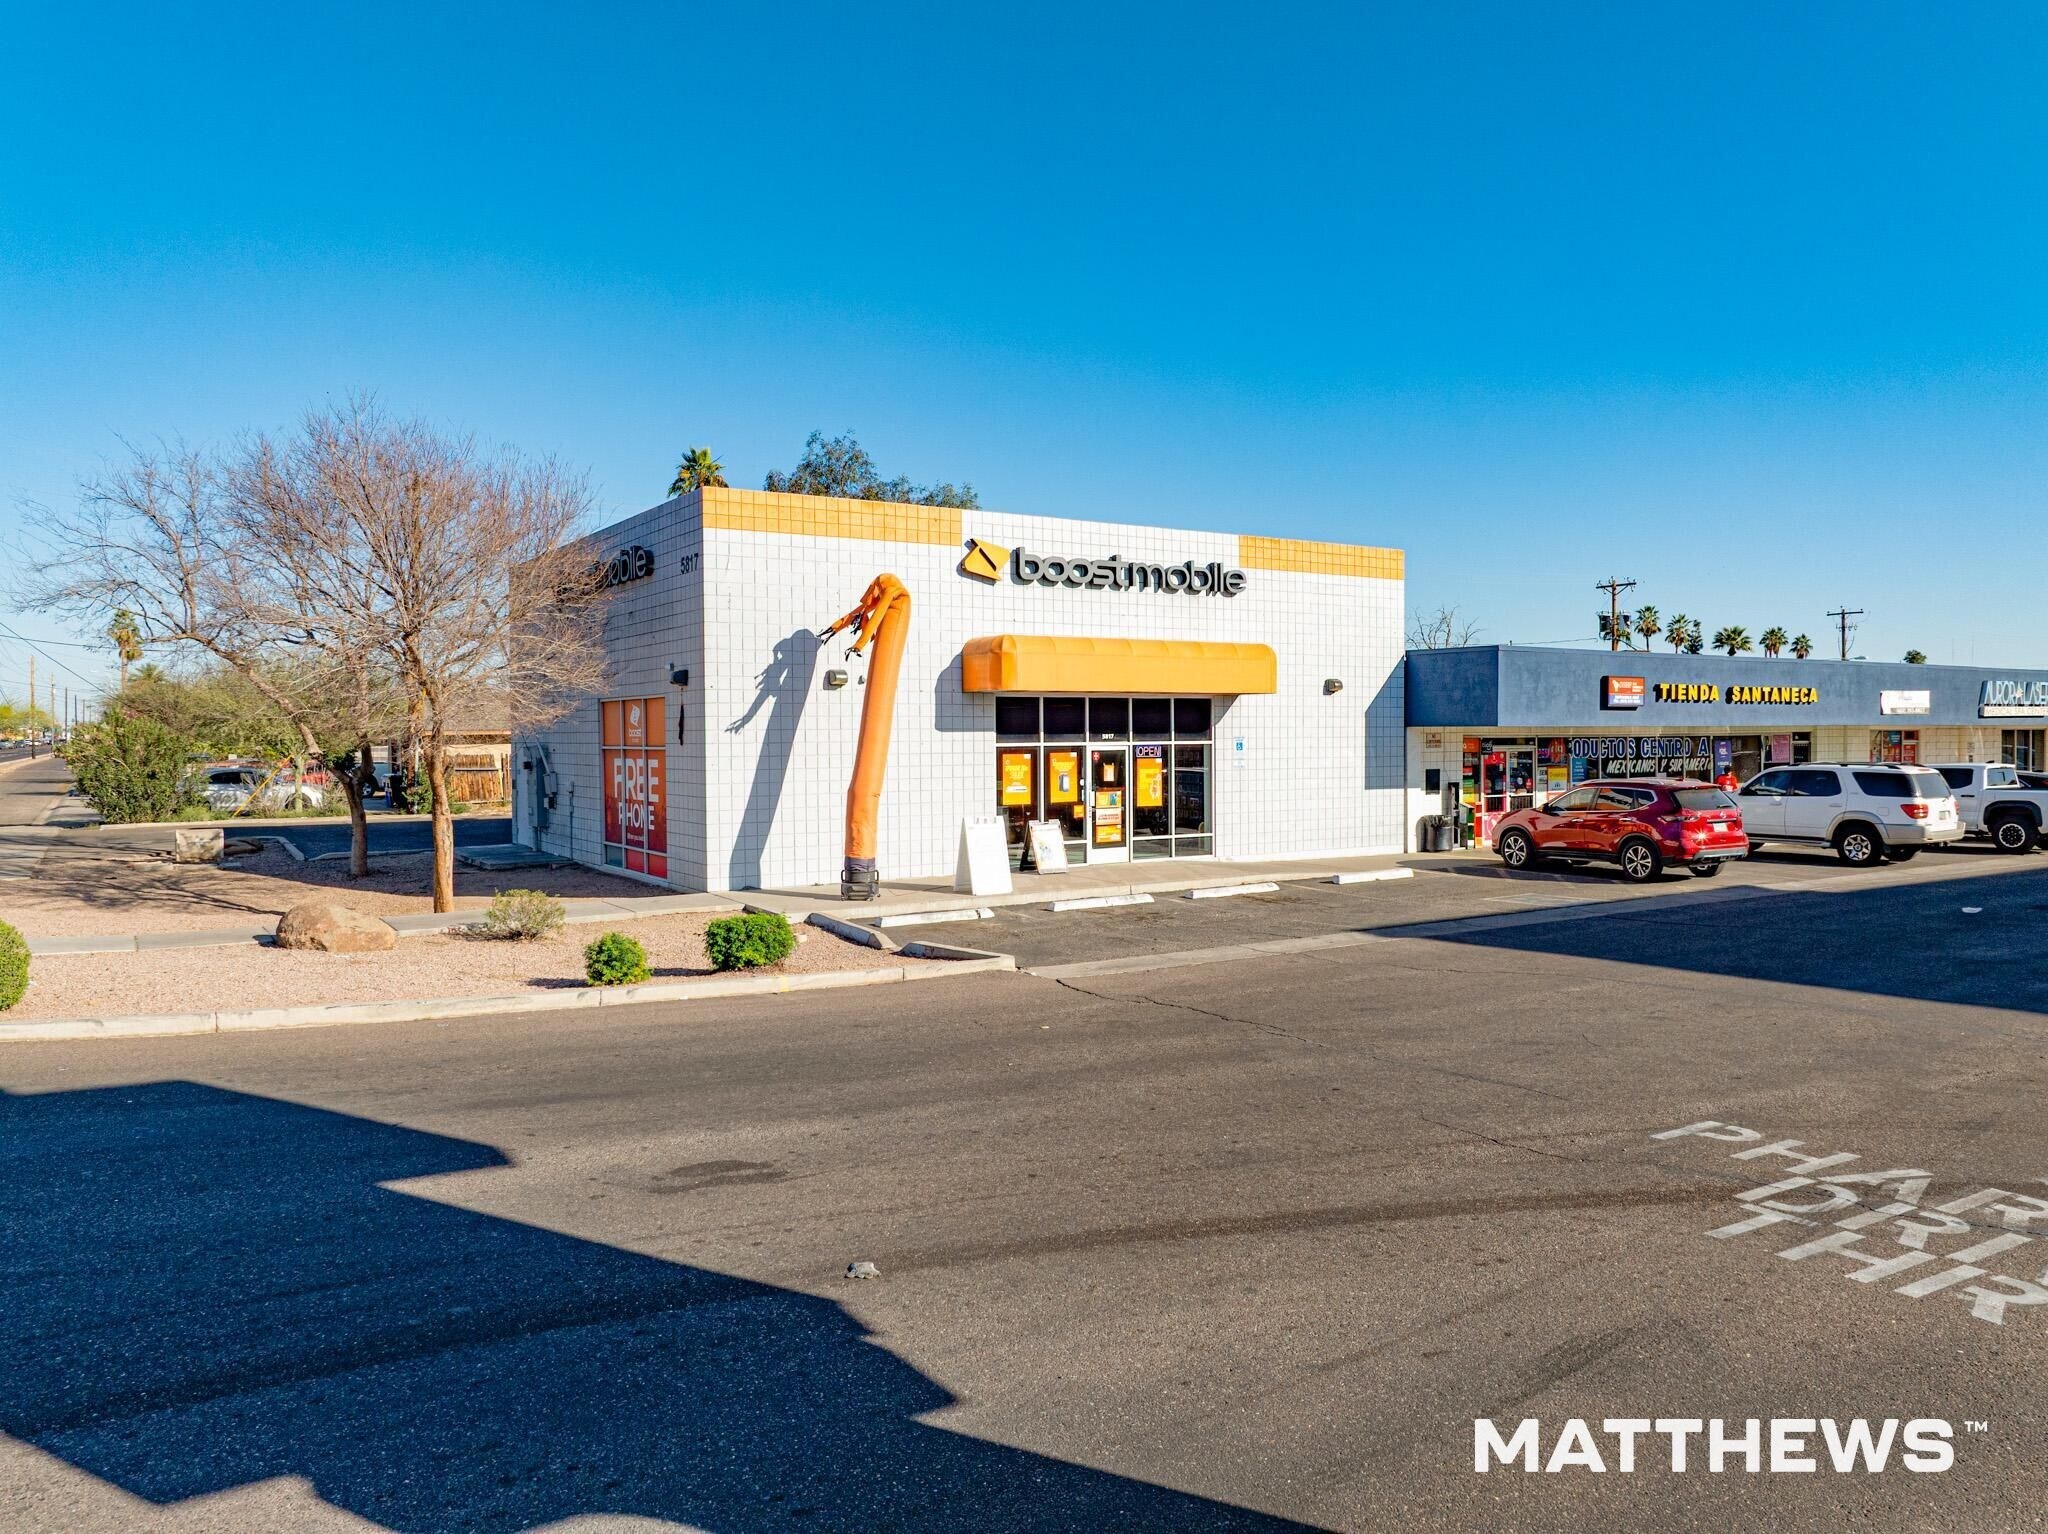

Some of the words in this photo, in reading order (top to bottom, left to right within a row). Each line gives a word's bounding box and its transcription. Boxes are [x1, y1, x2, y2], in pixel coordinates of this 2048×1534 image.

[680, 553, 699, 574] 5817
[1659, 682, 1720, 703] TIENDA
[1732, 686, 1819, 704] SANTANECA
[1137, 746, 1160, 757] OPEN
[1641, 738, 1690, 757] CENTRO
[1607, 759, 1656, 774] MEXICANOS
[614, 758, 659, 803] FREE
[618, 802, 655, 831] PHONE
[1651, 1121, 2048, 1226] PHAR
[1735, 1176, 2048, 1287] DRI
